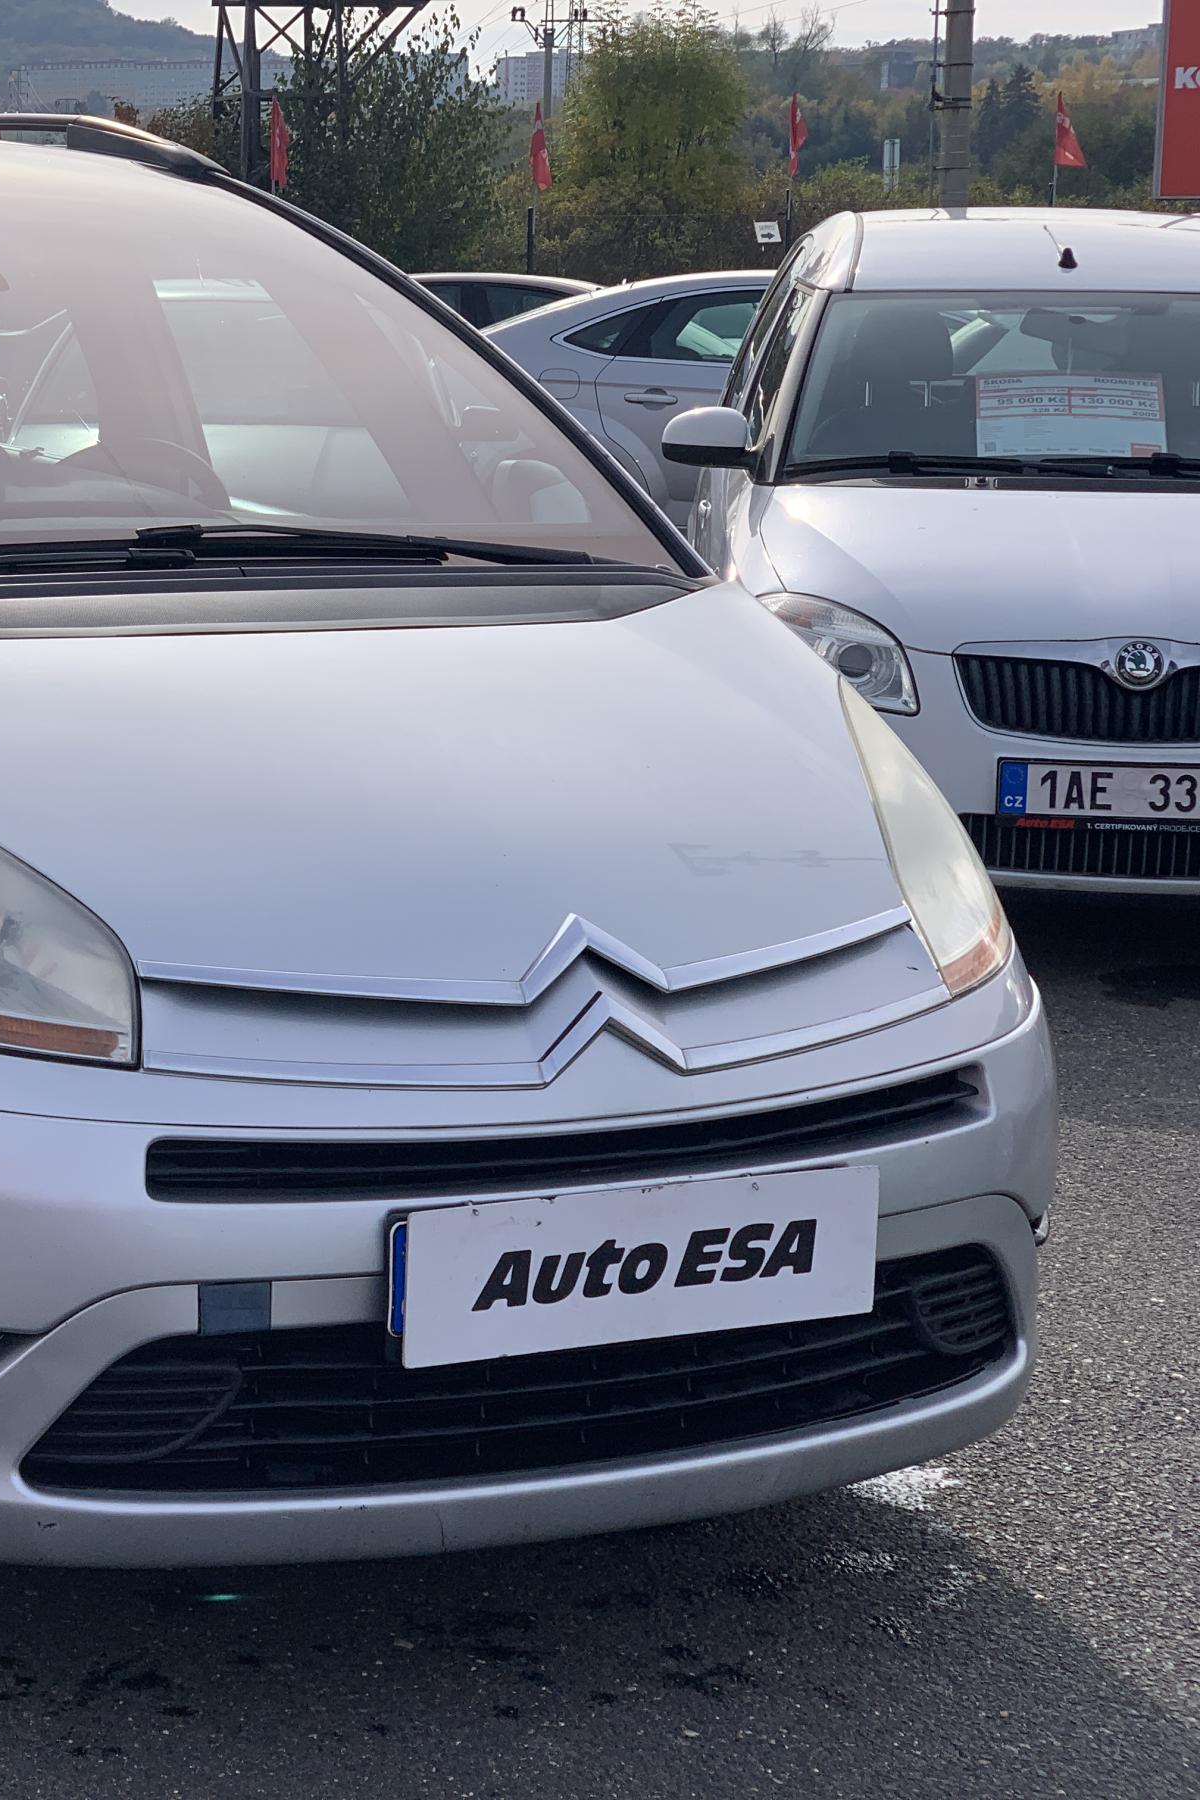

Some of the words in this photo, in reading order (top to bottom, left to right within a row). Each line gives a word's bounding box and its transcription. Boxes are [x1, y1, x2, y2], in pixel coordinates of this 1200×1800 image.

[1018, 397, 1044, 405] 000
[1080, 397, 1105, 405] 130
[1040, 770, 1114, 811] 1AE
[1149, 773, 1198, 813] 33
[1004, 795, 1023, 808] CZ
[1094, 822, 1158, 832] CERTIFIKOVANÝ
[471, 1239, 669, 1313] Auto
[673, 1218, 818, 1288] ESA
